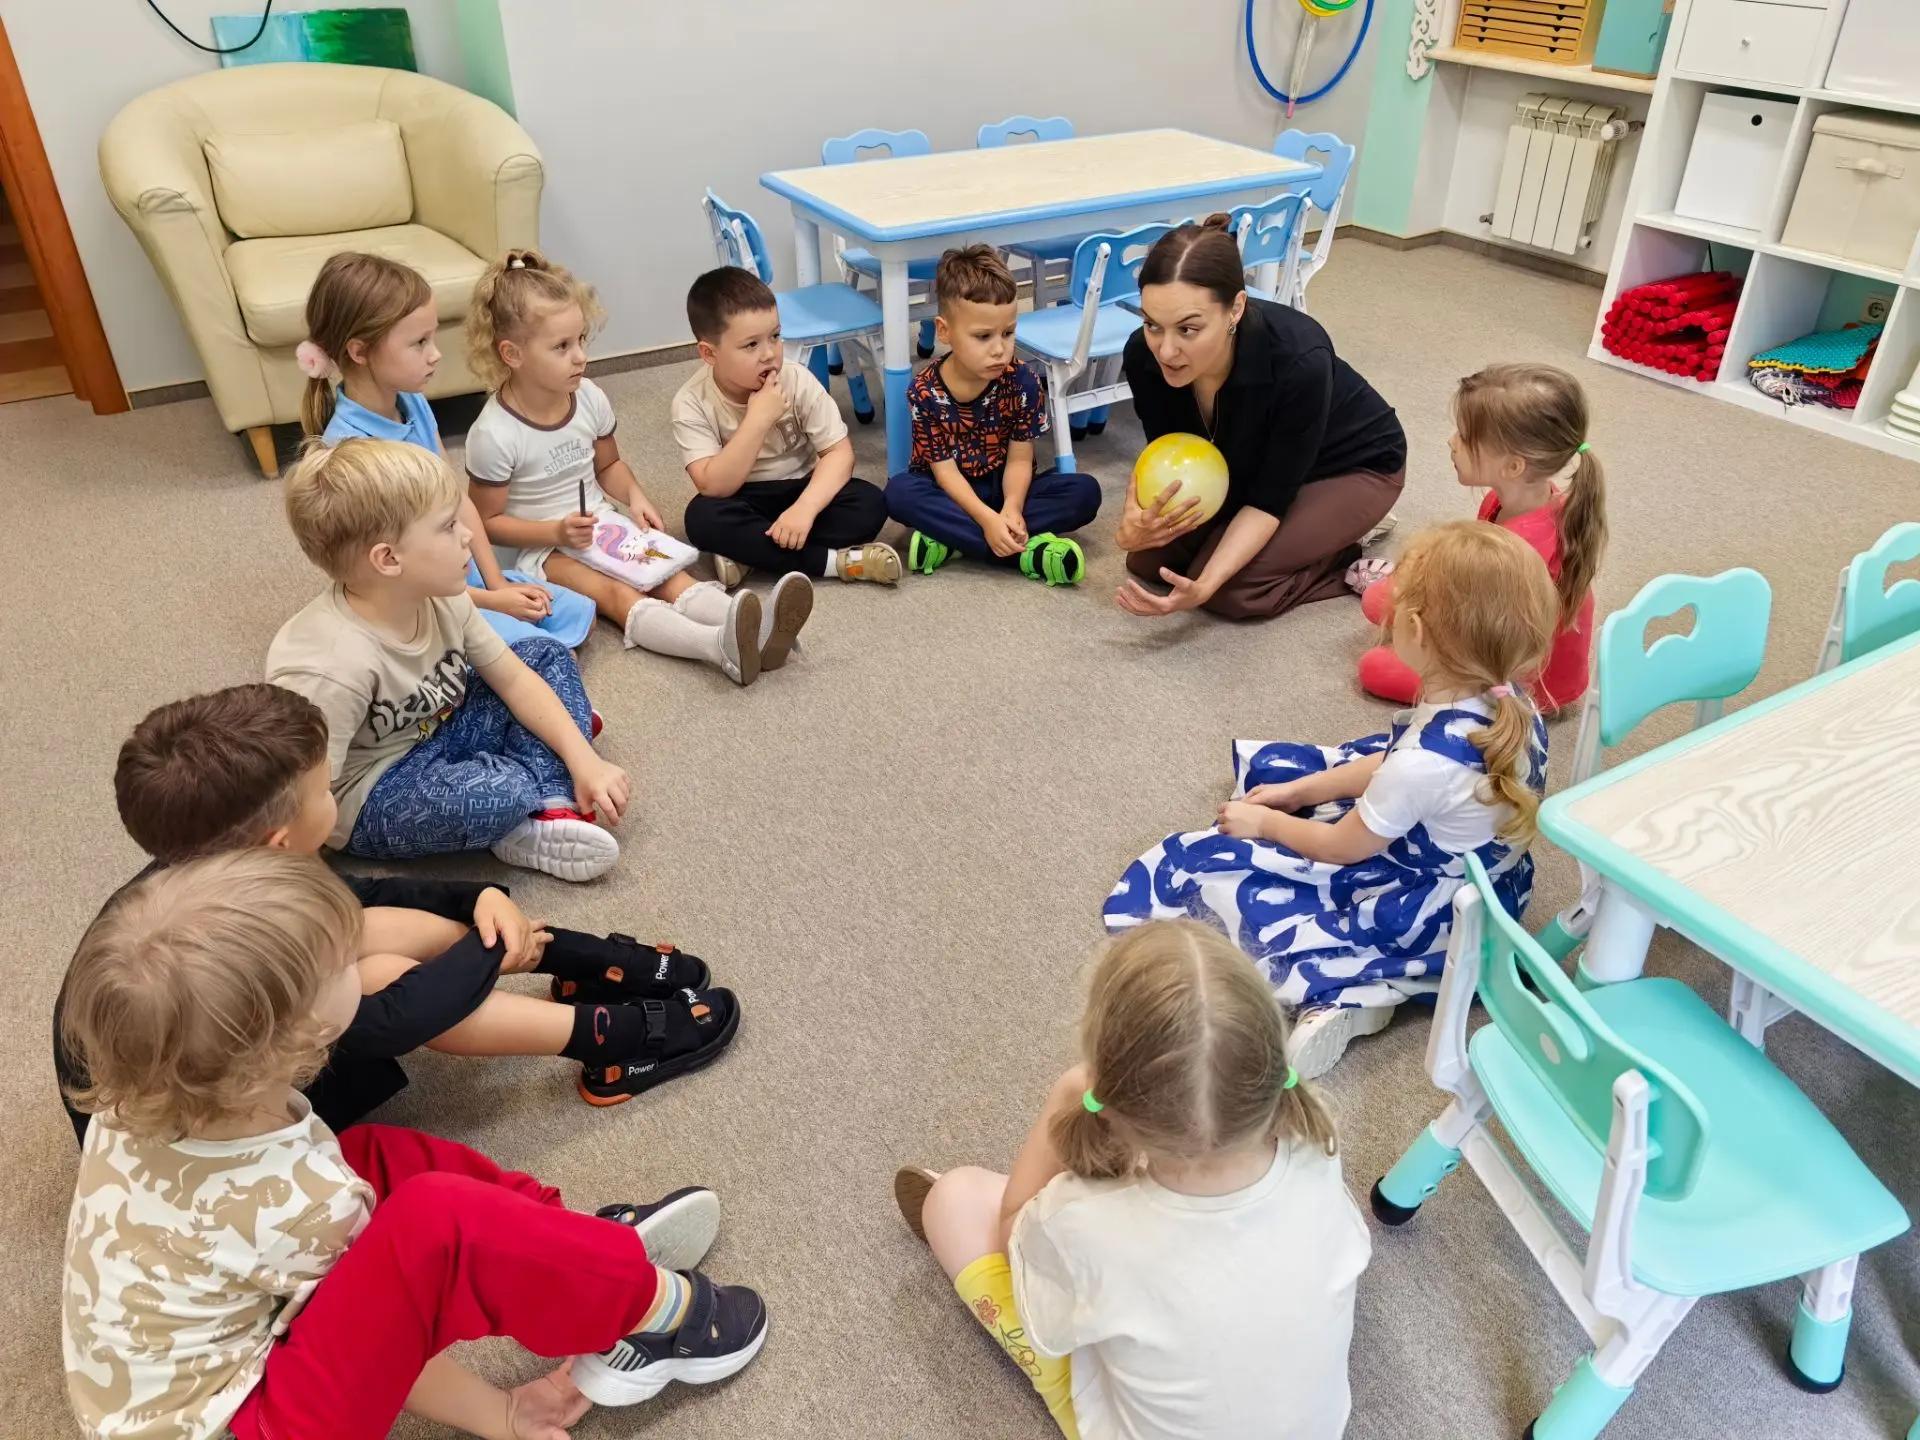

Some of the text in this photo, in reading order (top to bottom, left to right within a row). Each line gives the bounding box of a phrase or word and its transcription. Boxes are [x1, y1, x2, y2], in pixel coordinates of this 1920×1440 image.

[548, 438, 582, 460] LITTLE
[543, 448, 590, 476] SUNSHINE
[656, 954, 669, 980] Power
[628, 1063, 655, 1076] Power
